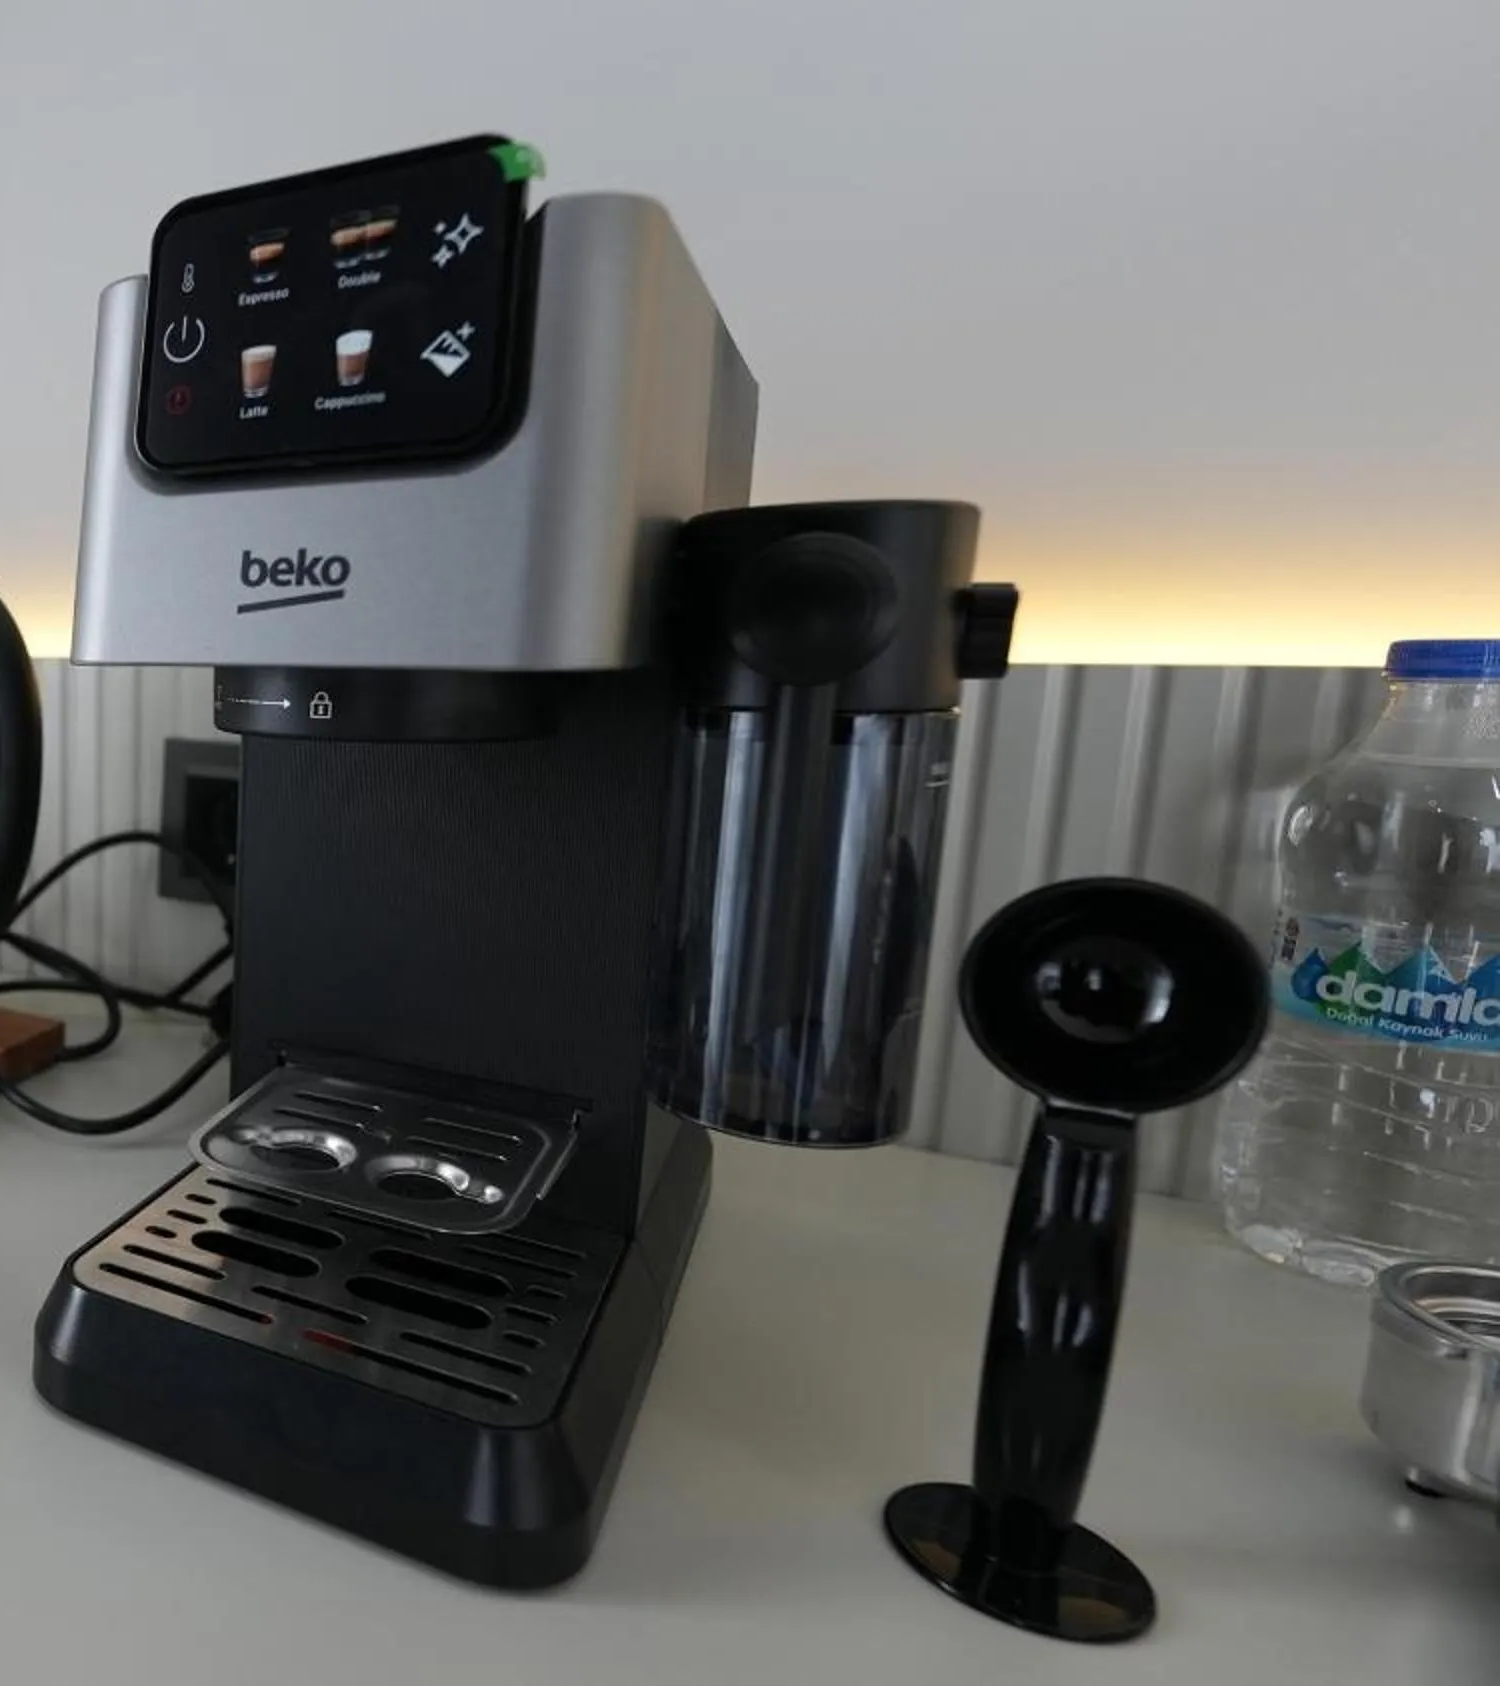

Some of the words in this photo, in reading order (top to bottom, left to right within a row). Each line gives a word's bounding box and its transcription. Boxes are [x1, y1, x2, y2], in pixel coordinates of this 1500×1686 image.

[338, 271, 382, 289] Double
[314, 391, 387, 411] Cappuccino
[239, 405, 269, 419] Latte
[240, 548, 350, 587] beko
[1378, 1017, 1444, 1039] Kaynak
